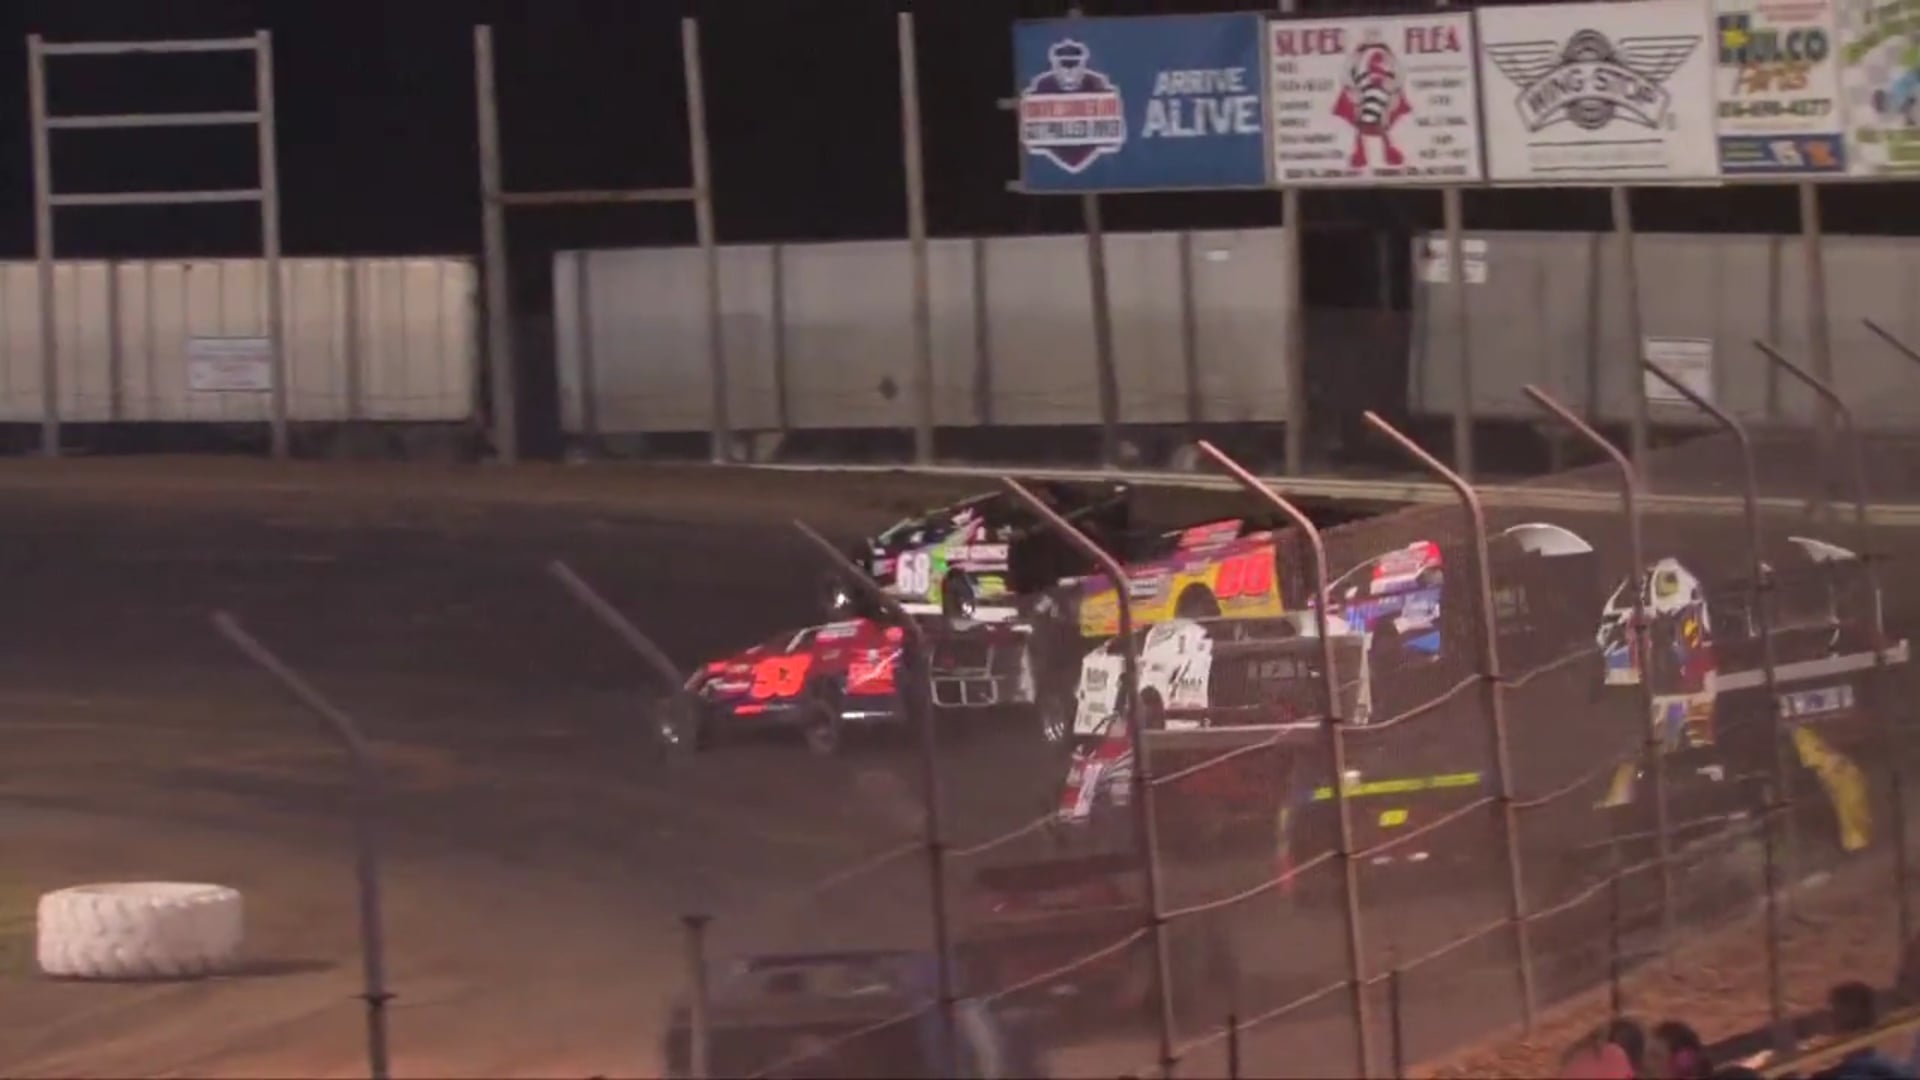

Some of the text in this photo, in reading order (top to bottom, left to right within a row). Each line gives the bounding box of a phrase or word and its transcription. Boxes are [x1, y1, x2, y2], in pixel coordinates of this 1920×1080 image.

[1405, 26, 1461, 54] FLEA
[1152, 67, 1247, 96] ARRIVE
[1142, 95, 1261, 138] ALIVE
